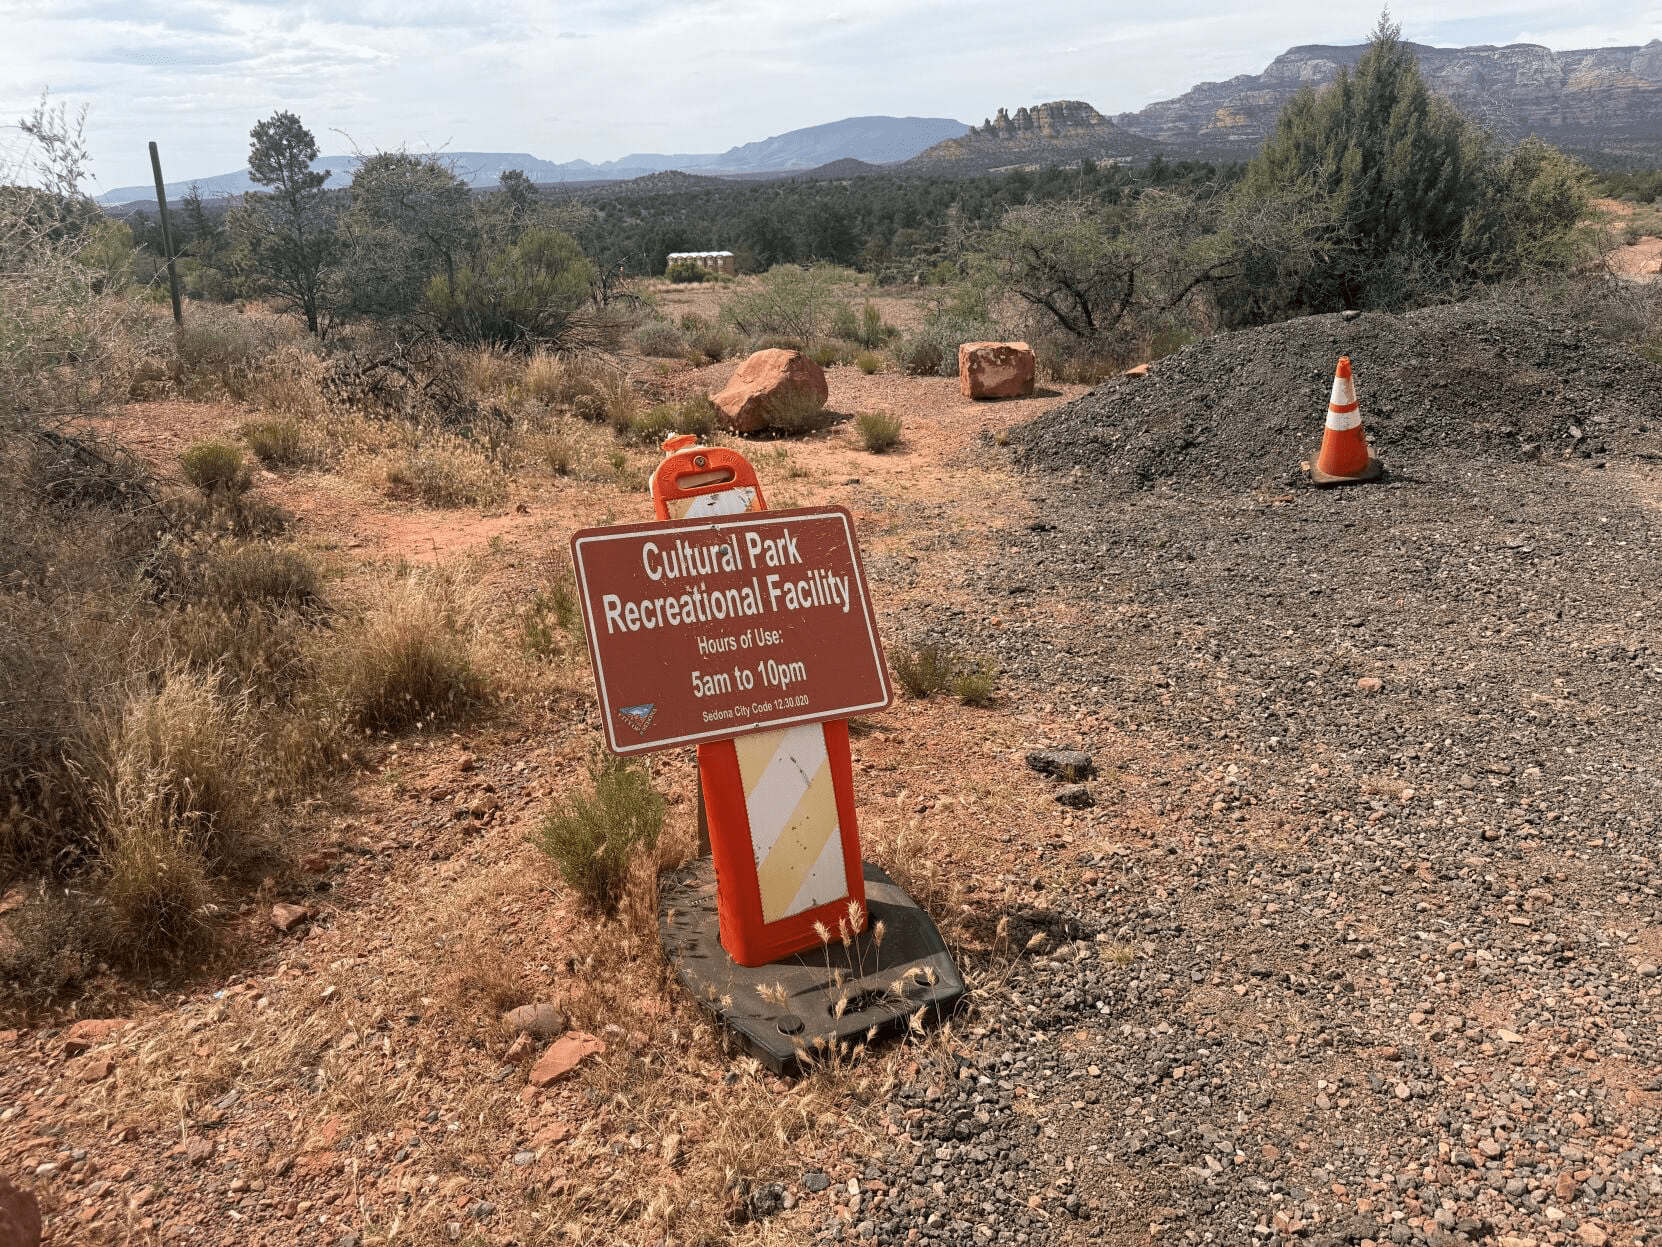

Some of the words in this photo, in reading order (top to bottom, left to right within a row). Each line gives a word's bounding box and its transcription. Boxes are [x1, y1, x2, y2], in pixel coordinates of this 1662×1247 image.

[643, 532, 742, 580] Cultural
[745, 528, 802, 568] Park
[603, 576, 763, 634] Recreational
[766, 569, 850, 614] Facility
[697, 635, 737, 655] Hours
[739, 630, 752, 648] of
[755, 628, 784, 647] Use:
[692, 670, 732, 697] 5am
[734, 665, 754, 690] to
[758, 660, 807, 690] 10pm
[702, 708, 733, 722] Sedona
[734, 703, 751, 718] City
[752, 701, 772, 714] Code
